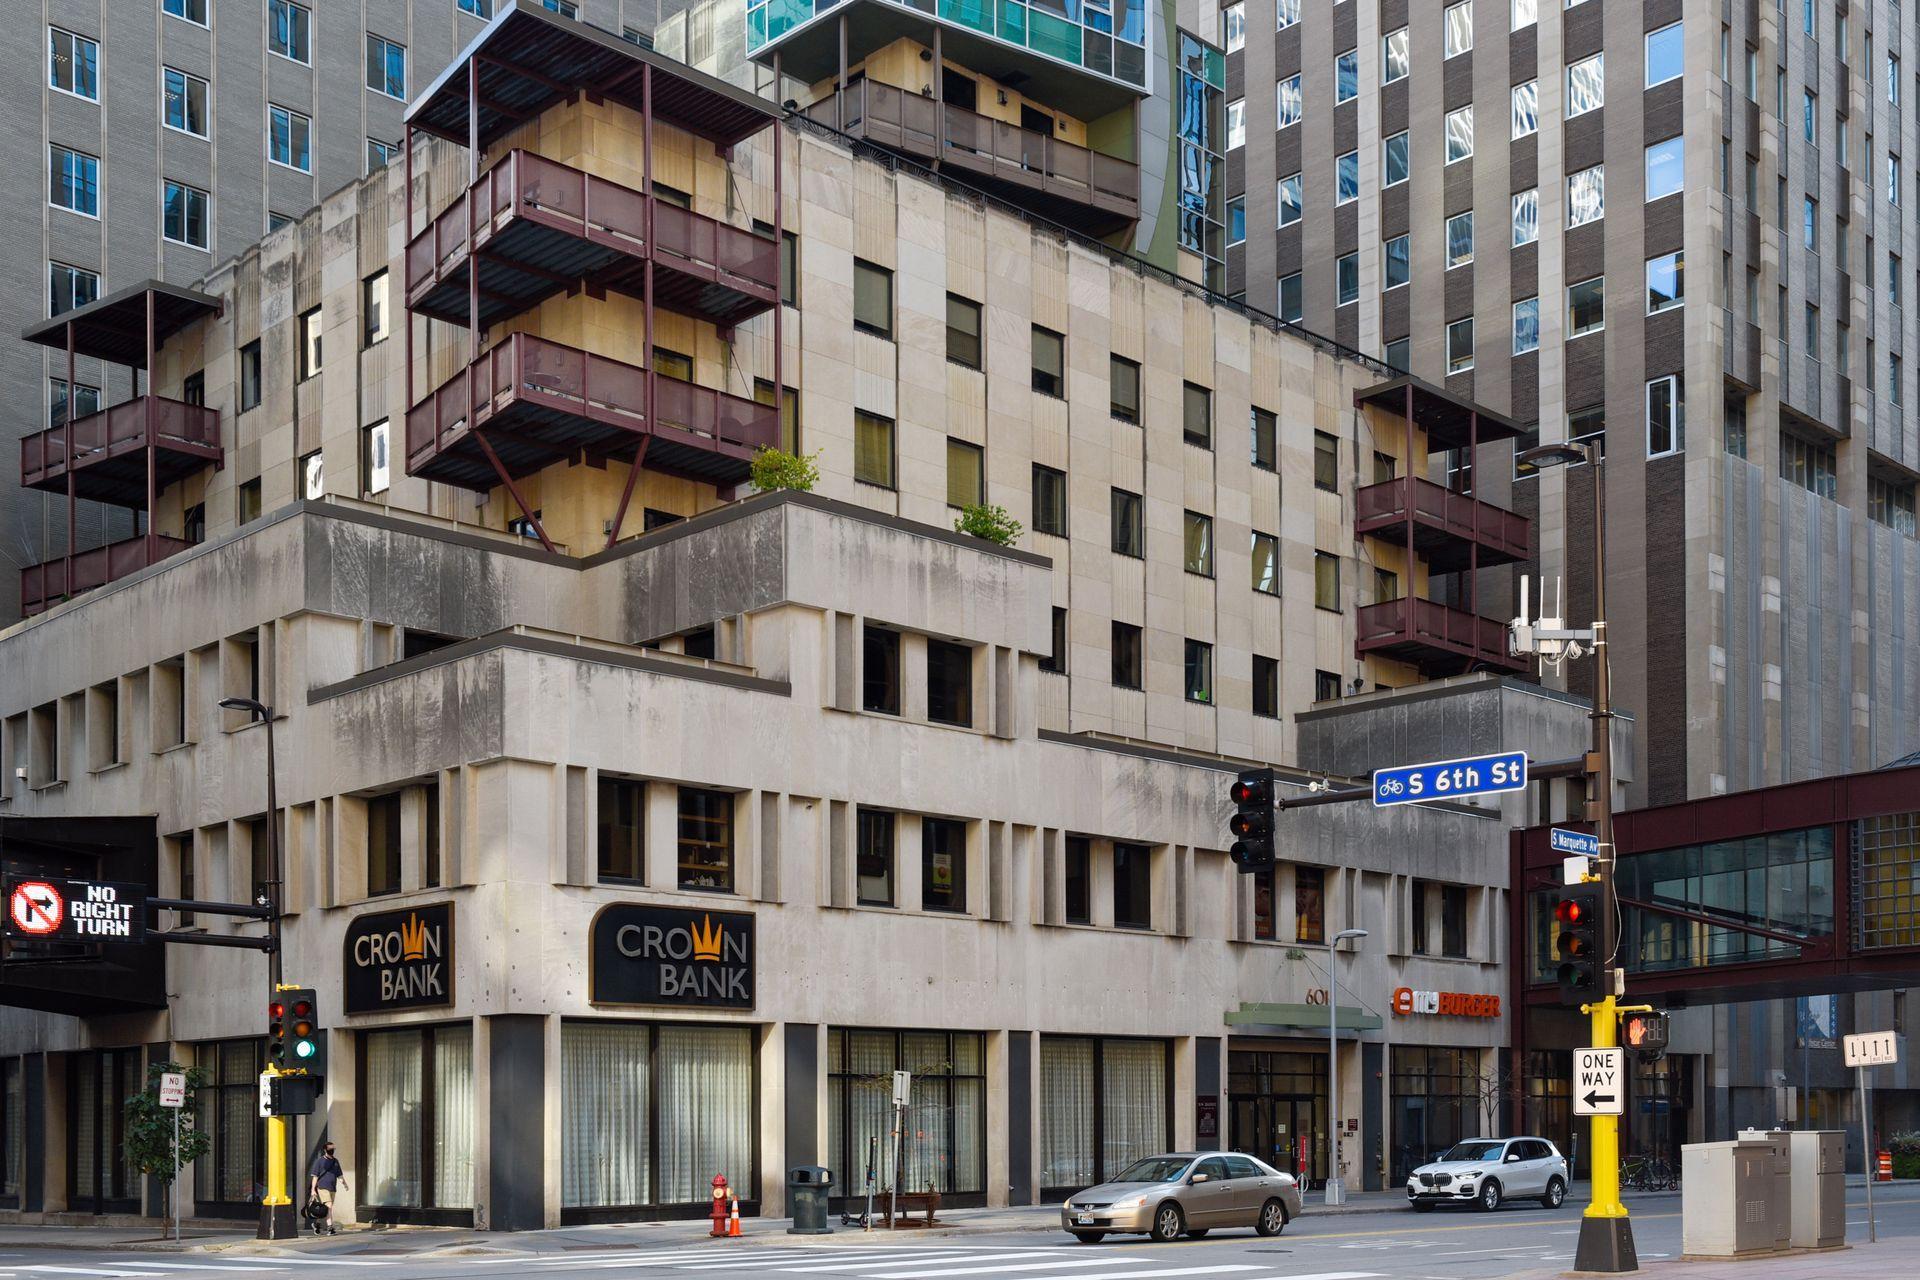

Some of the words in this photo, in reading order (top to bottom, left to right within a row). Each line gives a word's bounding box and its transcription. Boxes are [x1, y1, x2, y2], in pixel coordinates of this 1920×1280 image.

[1409, 773, 1423, 794] S
[1435, 766, 1479, 791] 6th
[1492, 761, 1520, 784] St
[1553, 832, 1557, 846] S
[1559, 833, 1587, 851] Marquette
[87, 886, 116, 903] NO
[71, 901, 134, 920] RIGHT
[73, 917, 130, 936] TURN
[381, 963, 444, 1001] BANK
[660, 963, 749, 1000] BANK
[1305, 989, 1328, 1005] 601
[1583, 1054, 1614, 1069] ONE
[169, 1077, 179, 1085] NO
[1582, 1071, 1615, 1086] WAY
